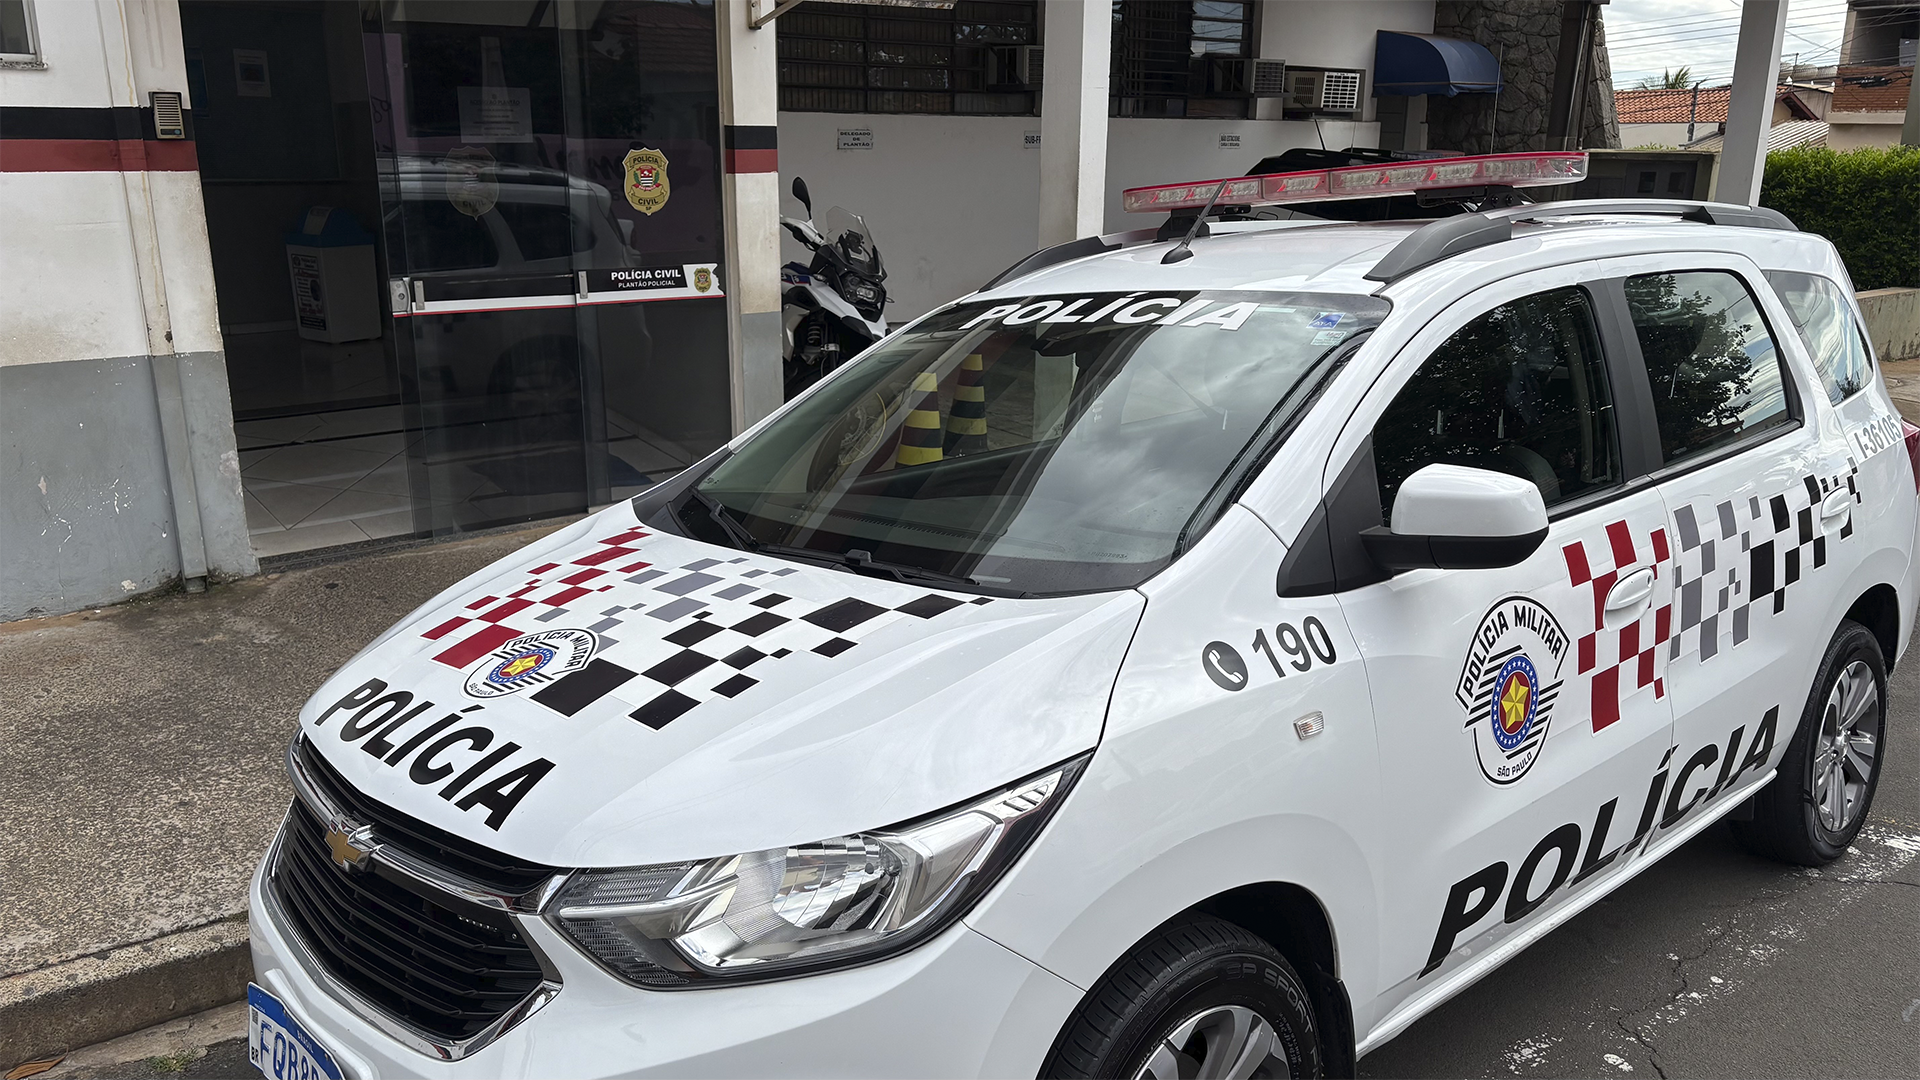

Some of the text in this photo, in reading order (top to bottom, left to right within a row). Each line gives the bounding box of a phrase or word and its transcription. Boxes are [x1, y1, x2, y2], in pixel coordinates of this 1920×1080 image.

[633, 155, 659, 164] POLÍCIA
[611, 269, 682, 281] POLÍCIA CIVIL
[618, 279, 647, 288] PLANTÃO
[959, 291, 1261, 331] POLÍCIA
[564, 634, 590, 669] MILITAR
[1251, 615, 1337, 679] 190
[1463, 604, 1563, 698] POLÍCIA MILITAR
[314, 677, 557, 832] POLÍCIA
[1497, 751, 1533, 777] SÃO PAULO
[1416, 704, 1781, 982] POLÍCIA
[1226, 962, 1313, 1033] SP SPORT
